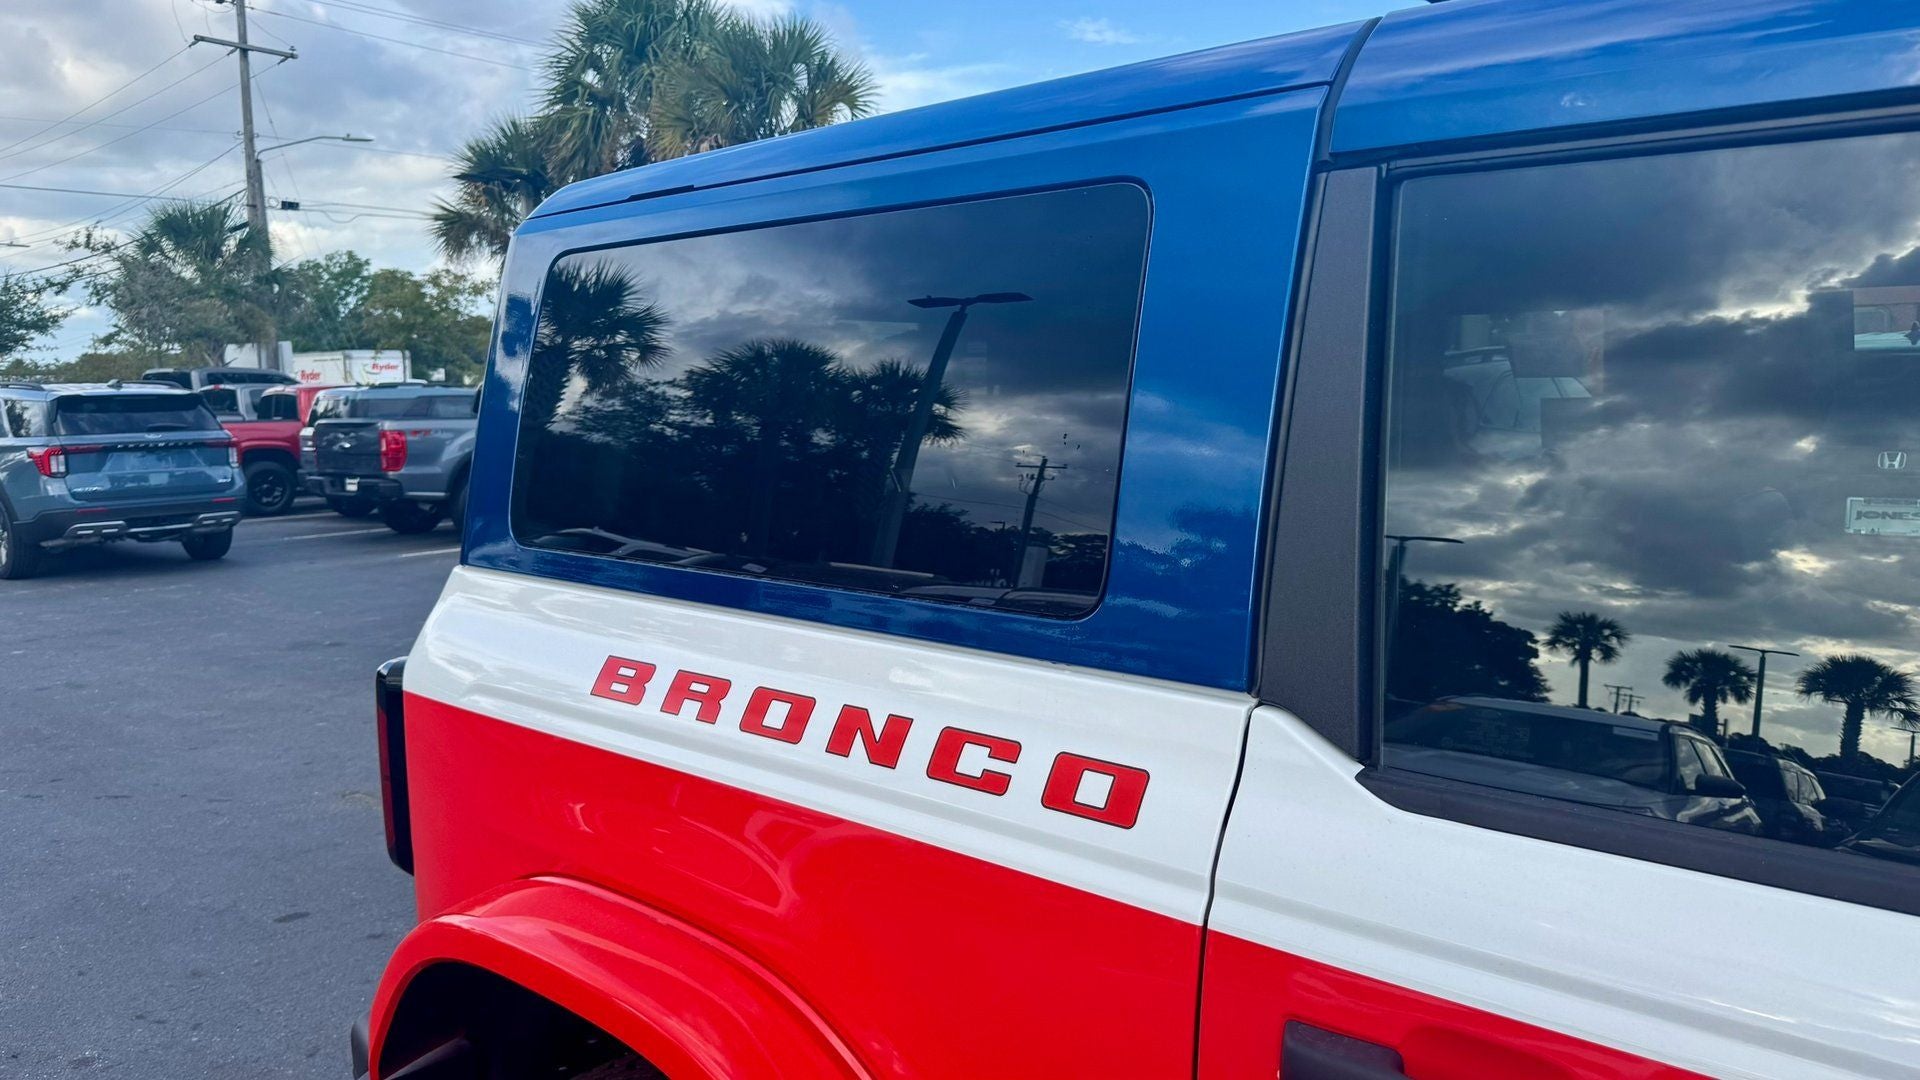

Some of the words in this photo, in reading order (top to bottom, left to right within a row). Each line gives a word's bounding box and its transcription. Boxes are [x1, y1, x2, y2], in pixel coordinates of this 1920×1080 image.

[371, 363, 399, 371] Ryder
[300, 369, 321, 382] Ryder
[590, 655, 1150, 830] BRONCO
